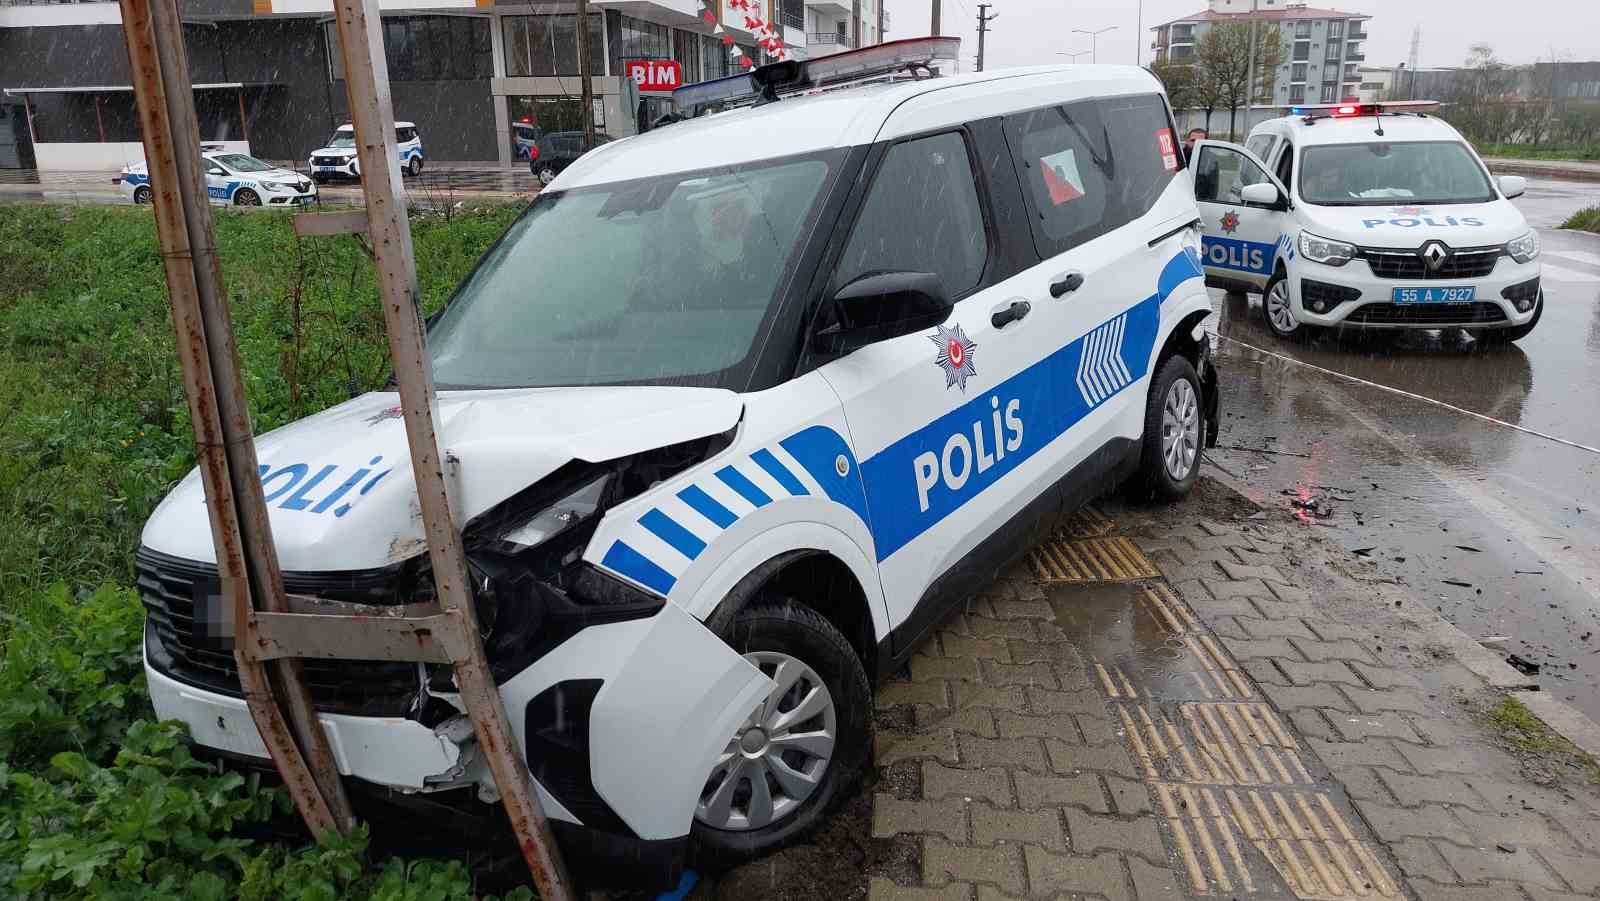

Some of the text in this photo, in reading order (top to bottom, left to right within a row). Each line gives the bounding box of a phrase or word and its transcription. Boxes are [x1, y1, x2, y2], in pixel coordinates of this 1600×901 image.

[631, 61, 676, 85] BİM
[1401, 288, 1473, 302] 55 A 7927
[913, 395, 1024, 512] POLİS
[258, 455, 393, 518] OLİ
